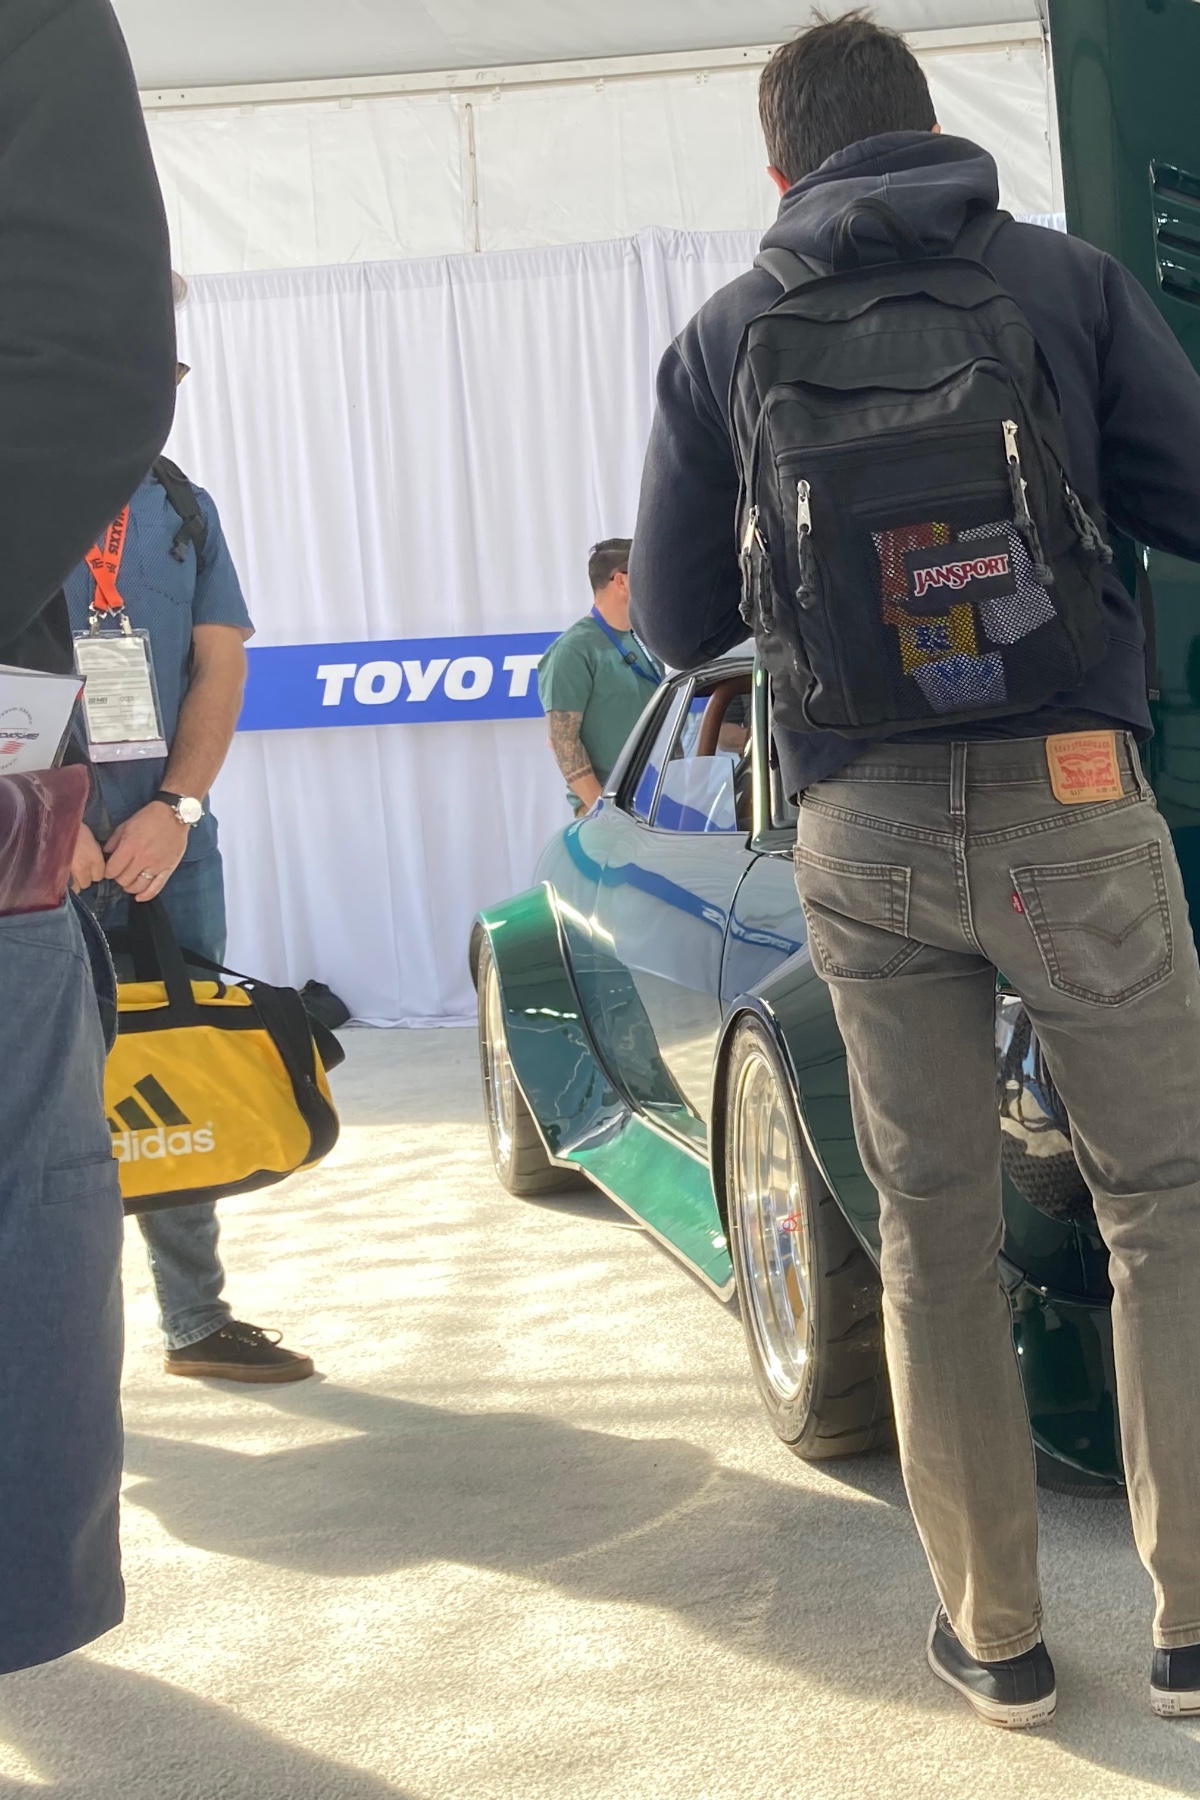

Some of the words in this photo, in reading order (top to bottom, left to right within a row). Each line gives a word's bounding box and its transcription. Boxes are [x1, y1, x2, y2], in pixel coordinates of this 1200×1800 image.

[913, 554, 1009, 597] JANSPORT
[316, 655, 494, 707] TOYO
[111, 1126, 216, 1163] didas
